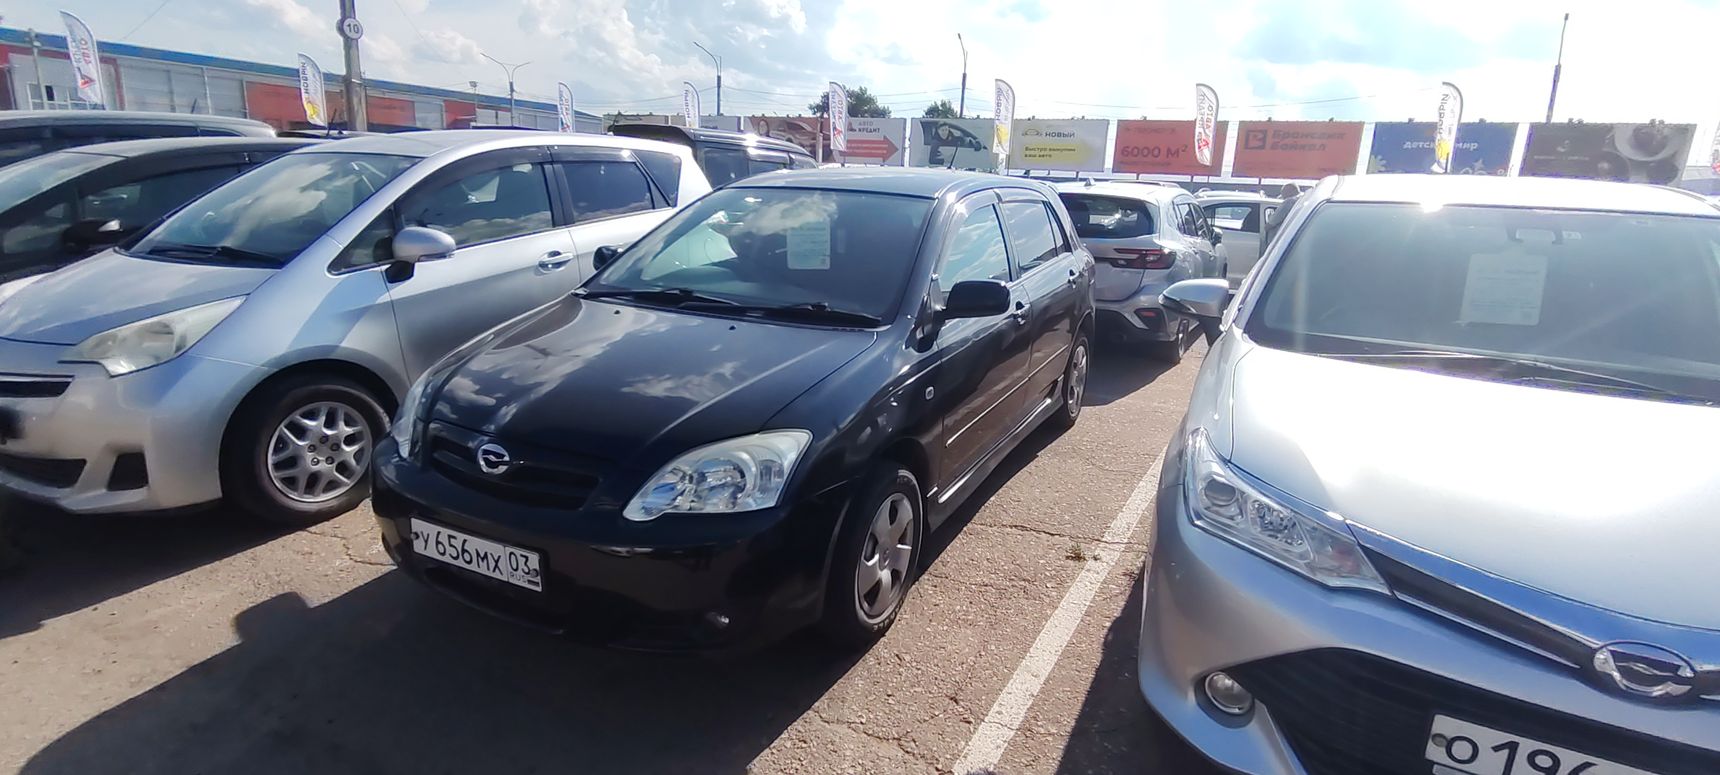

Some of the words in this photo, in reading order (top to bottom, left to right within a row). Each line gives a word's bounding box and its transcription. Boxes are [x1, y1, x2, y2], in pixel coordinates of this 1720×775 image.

[346, 23, 360, 34] 10
[1121, 146, 1160, 158] 6000
[508, 551, 531, 575] 03
[509, 572, 528, 584] RUS
[1445, 735, 1598, 775] О19
